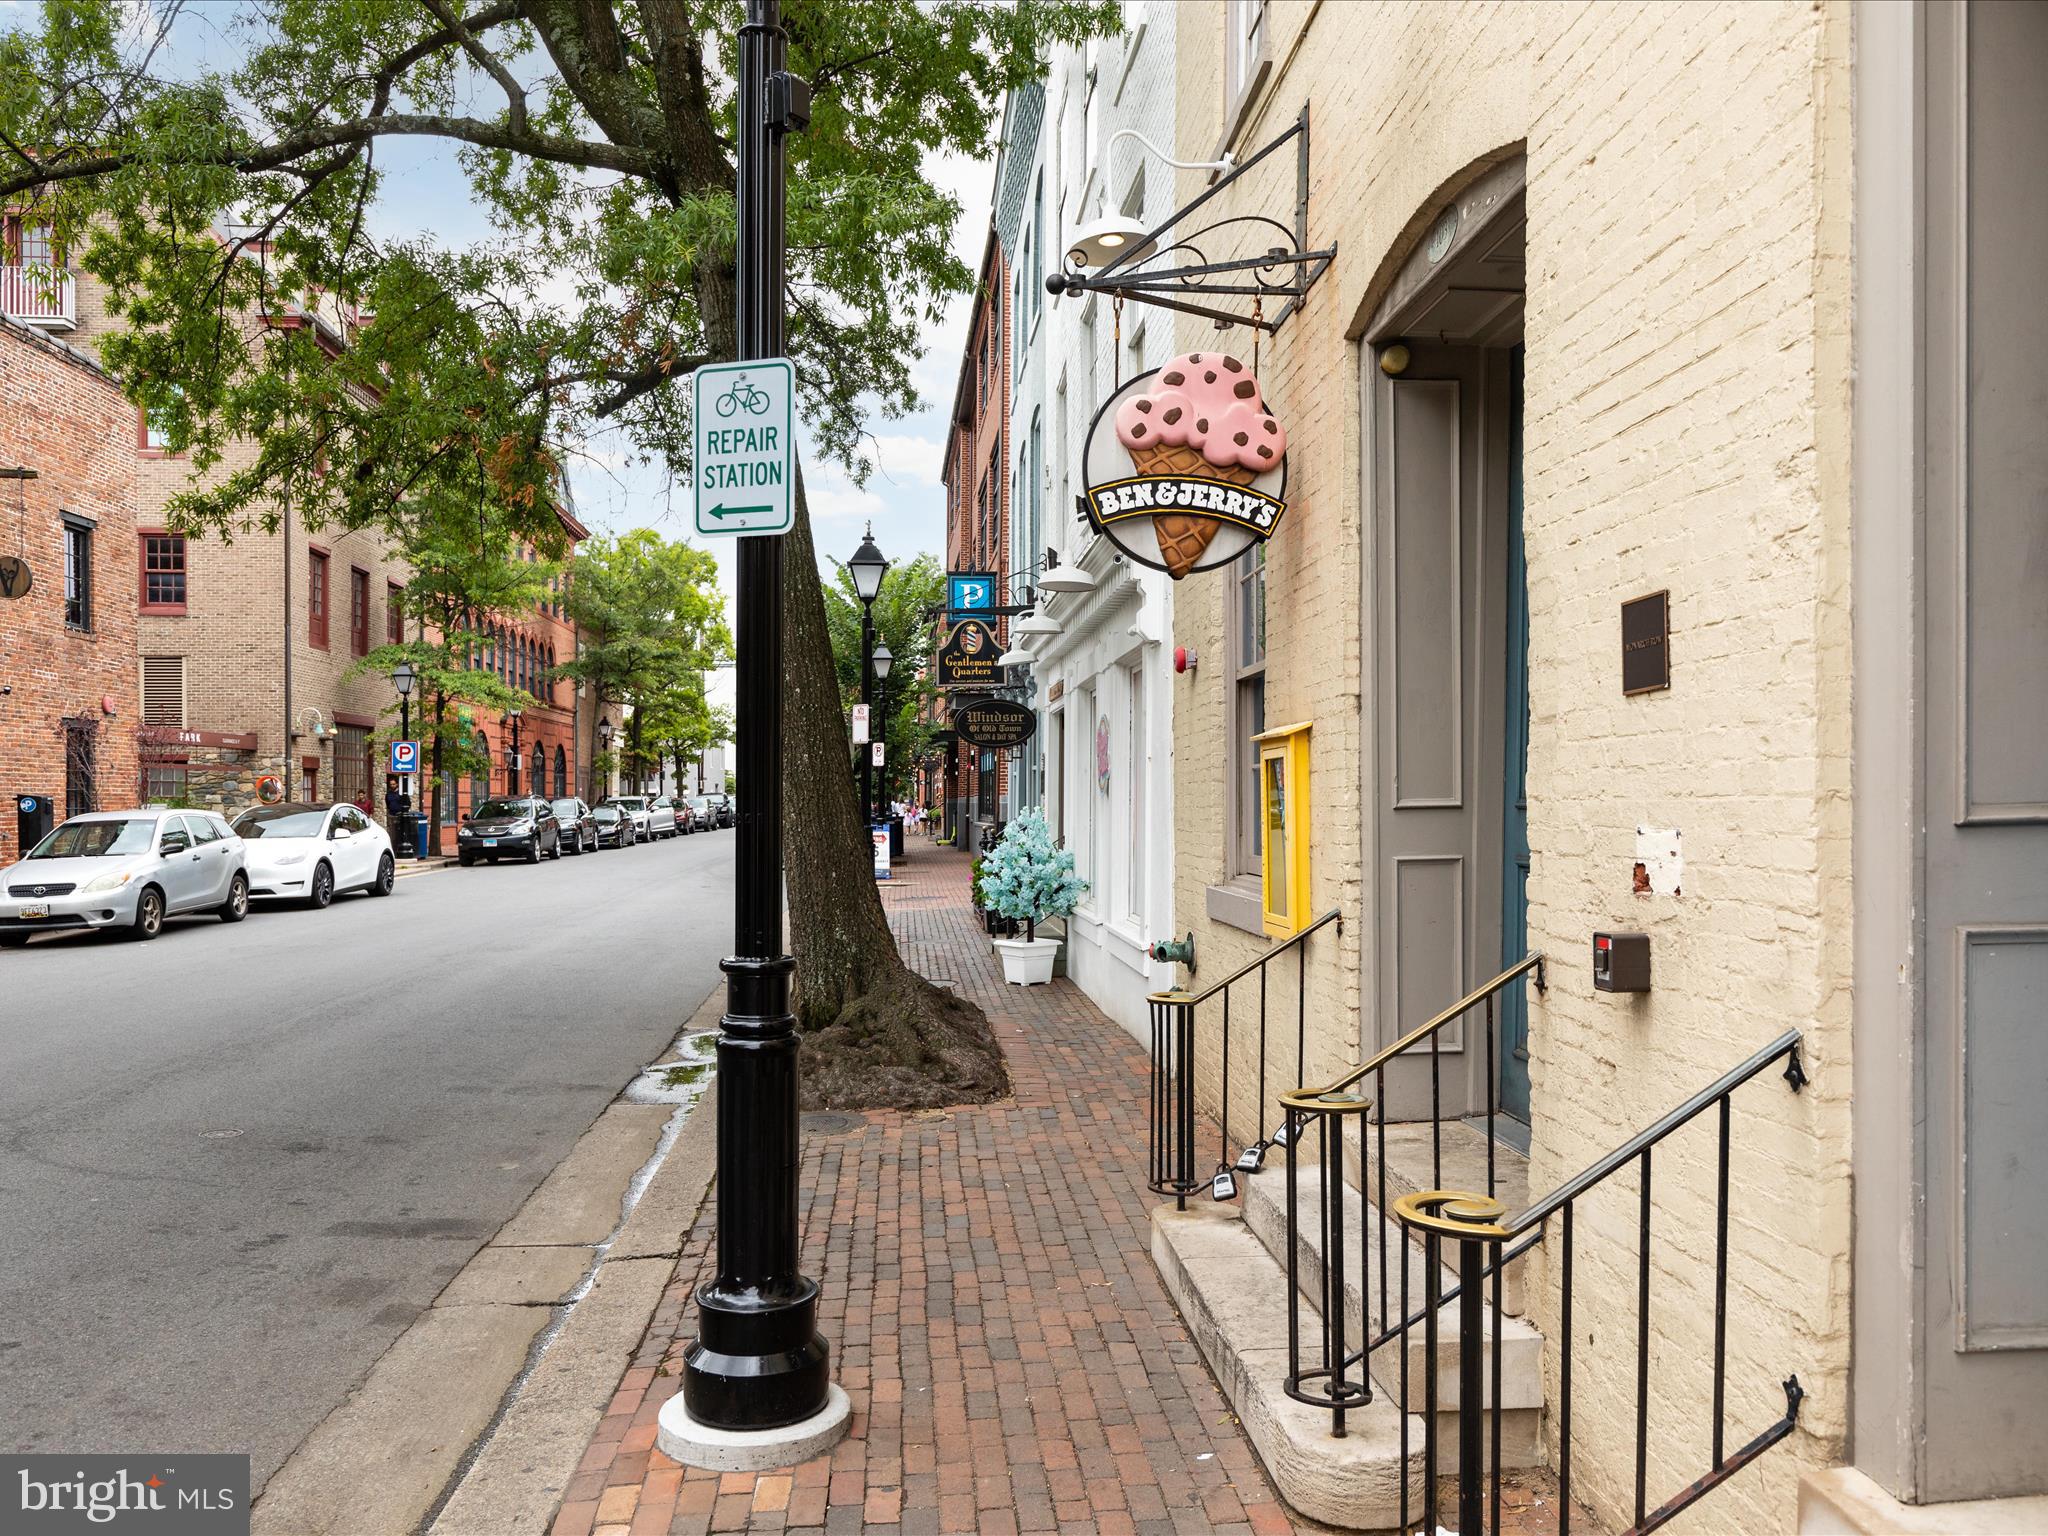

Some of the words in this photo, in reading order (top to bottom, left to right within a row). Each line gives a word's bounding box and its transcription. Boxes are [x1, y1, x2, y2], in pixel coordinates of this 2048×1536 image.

[707, 426, 778, 455] REPAIR
[704, 460, 782, 489] STATION
[1098, 483, 1154, 516] BEN
[1178, 482, 1277, 528] JERRY'S
[960, 583, 984, 609] P
[952, 666, 992, 679] Quarters
[966, 711, 1025, 723] Windsor
[981, 724, 997, 732] Old
[999, 724, 1022, 732] Town
[399, 746, 412, 760] P
